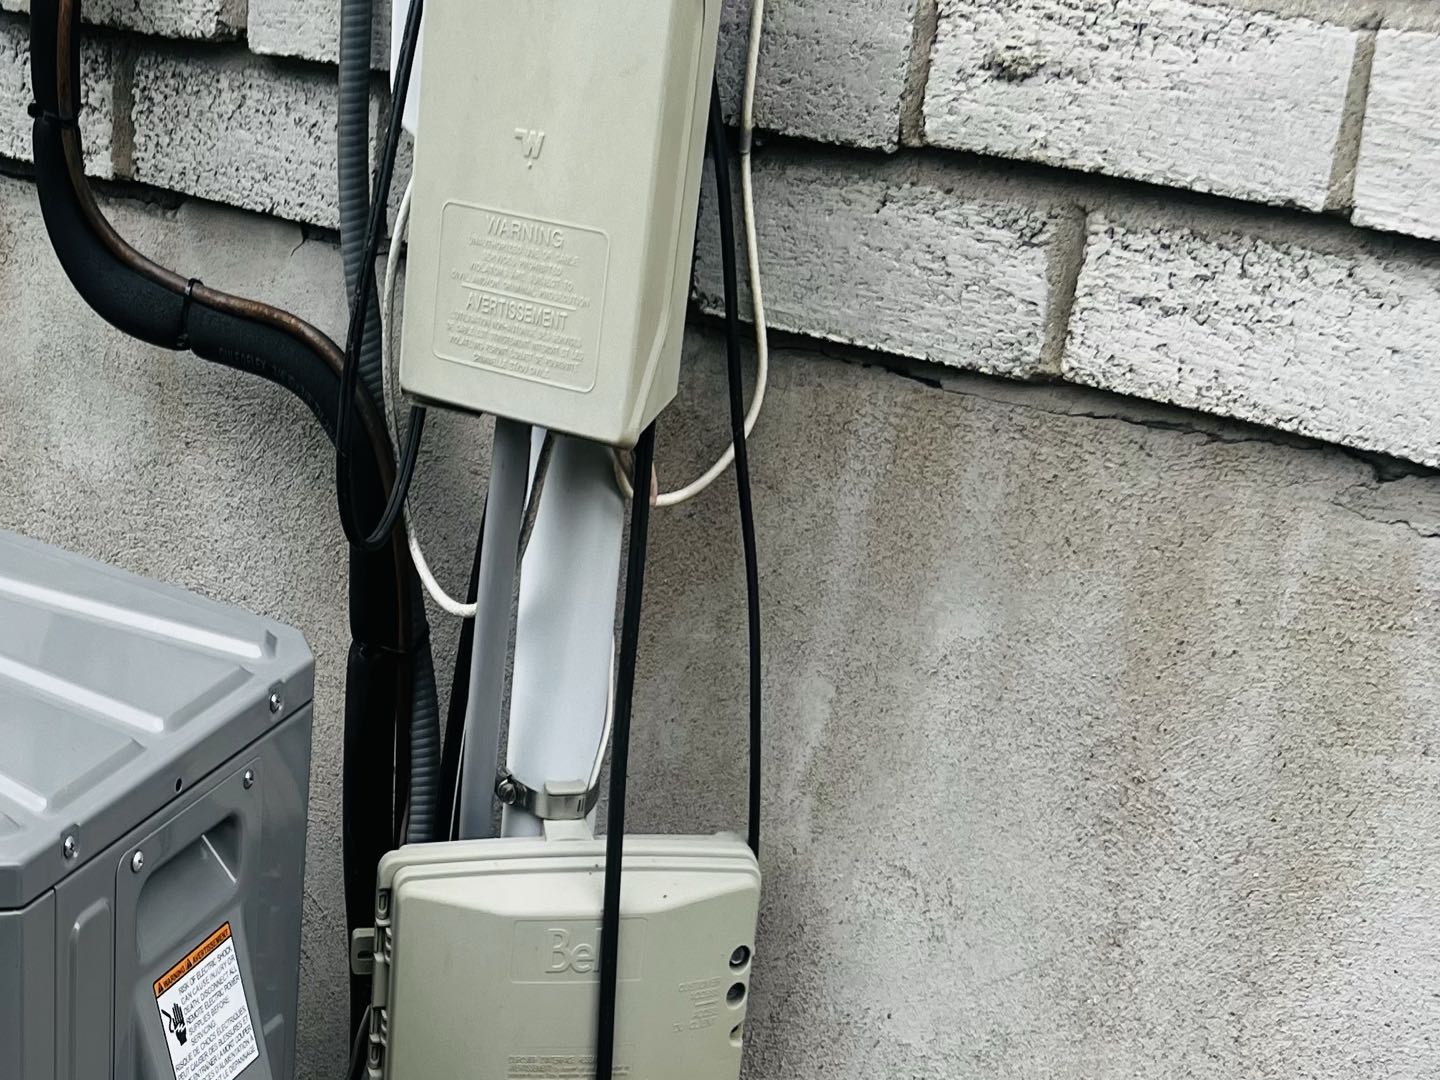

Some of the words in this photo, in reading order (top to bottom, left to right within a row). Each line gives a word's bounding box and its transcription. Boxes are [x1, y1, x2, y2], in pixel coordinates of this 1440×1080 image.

[485, 215, 566, 248] WARNING
[466, 291, 568, 330] AVERTISSEMENT
[163, 966, 185, 987] WARNING
[191, 929, 228, 964] AVERTISSEMENT
[189, 975, 195, 984] OF
[196, 958, 216, 979] ELECTRIC
[216, 945, 231, 961] SHOCK
[180, 990, 192, 1004] CAN
[192, 976, 209, 995] CAUSE
[209, 961, 226, 980] INJURY
[227, 954, 234, 965] OR
[200, 971, 229, 1000] DISCONNECT
[185, 1004, 204, 1025] REMOTE
[204, 987, 224, 1009] ELECTRIC
[223, 974, 239, 992] POWER
[188, 1012, 210, 1035] SUPPLIES
[210, 996, 228, 1016] BEFORE
[175, 1052, 192, 1072] RISQUE
[193, 1046, 199, 1056] DE
[189, 1050, 208, 1071] CAUSER
[208, 1042, 218, 1055] DES
[242, 1014, 248, 1024] ET
